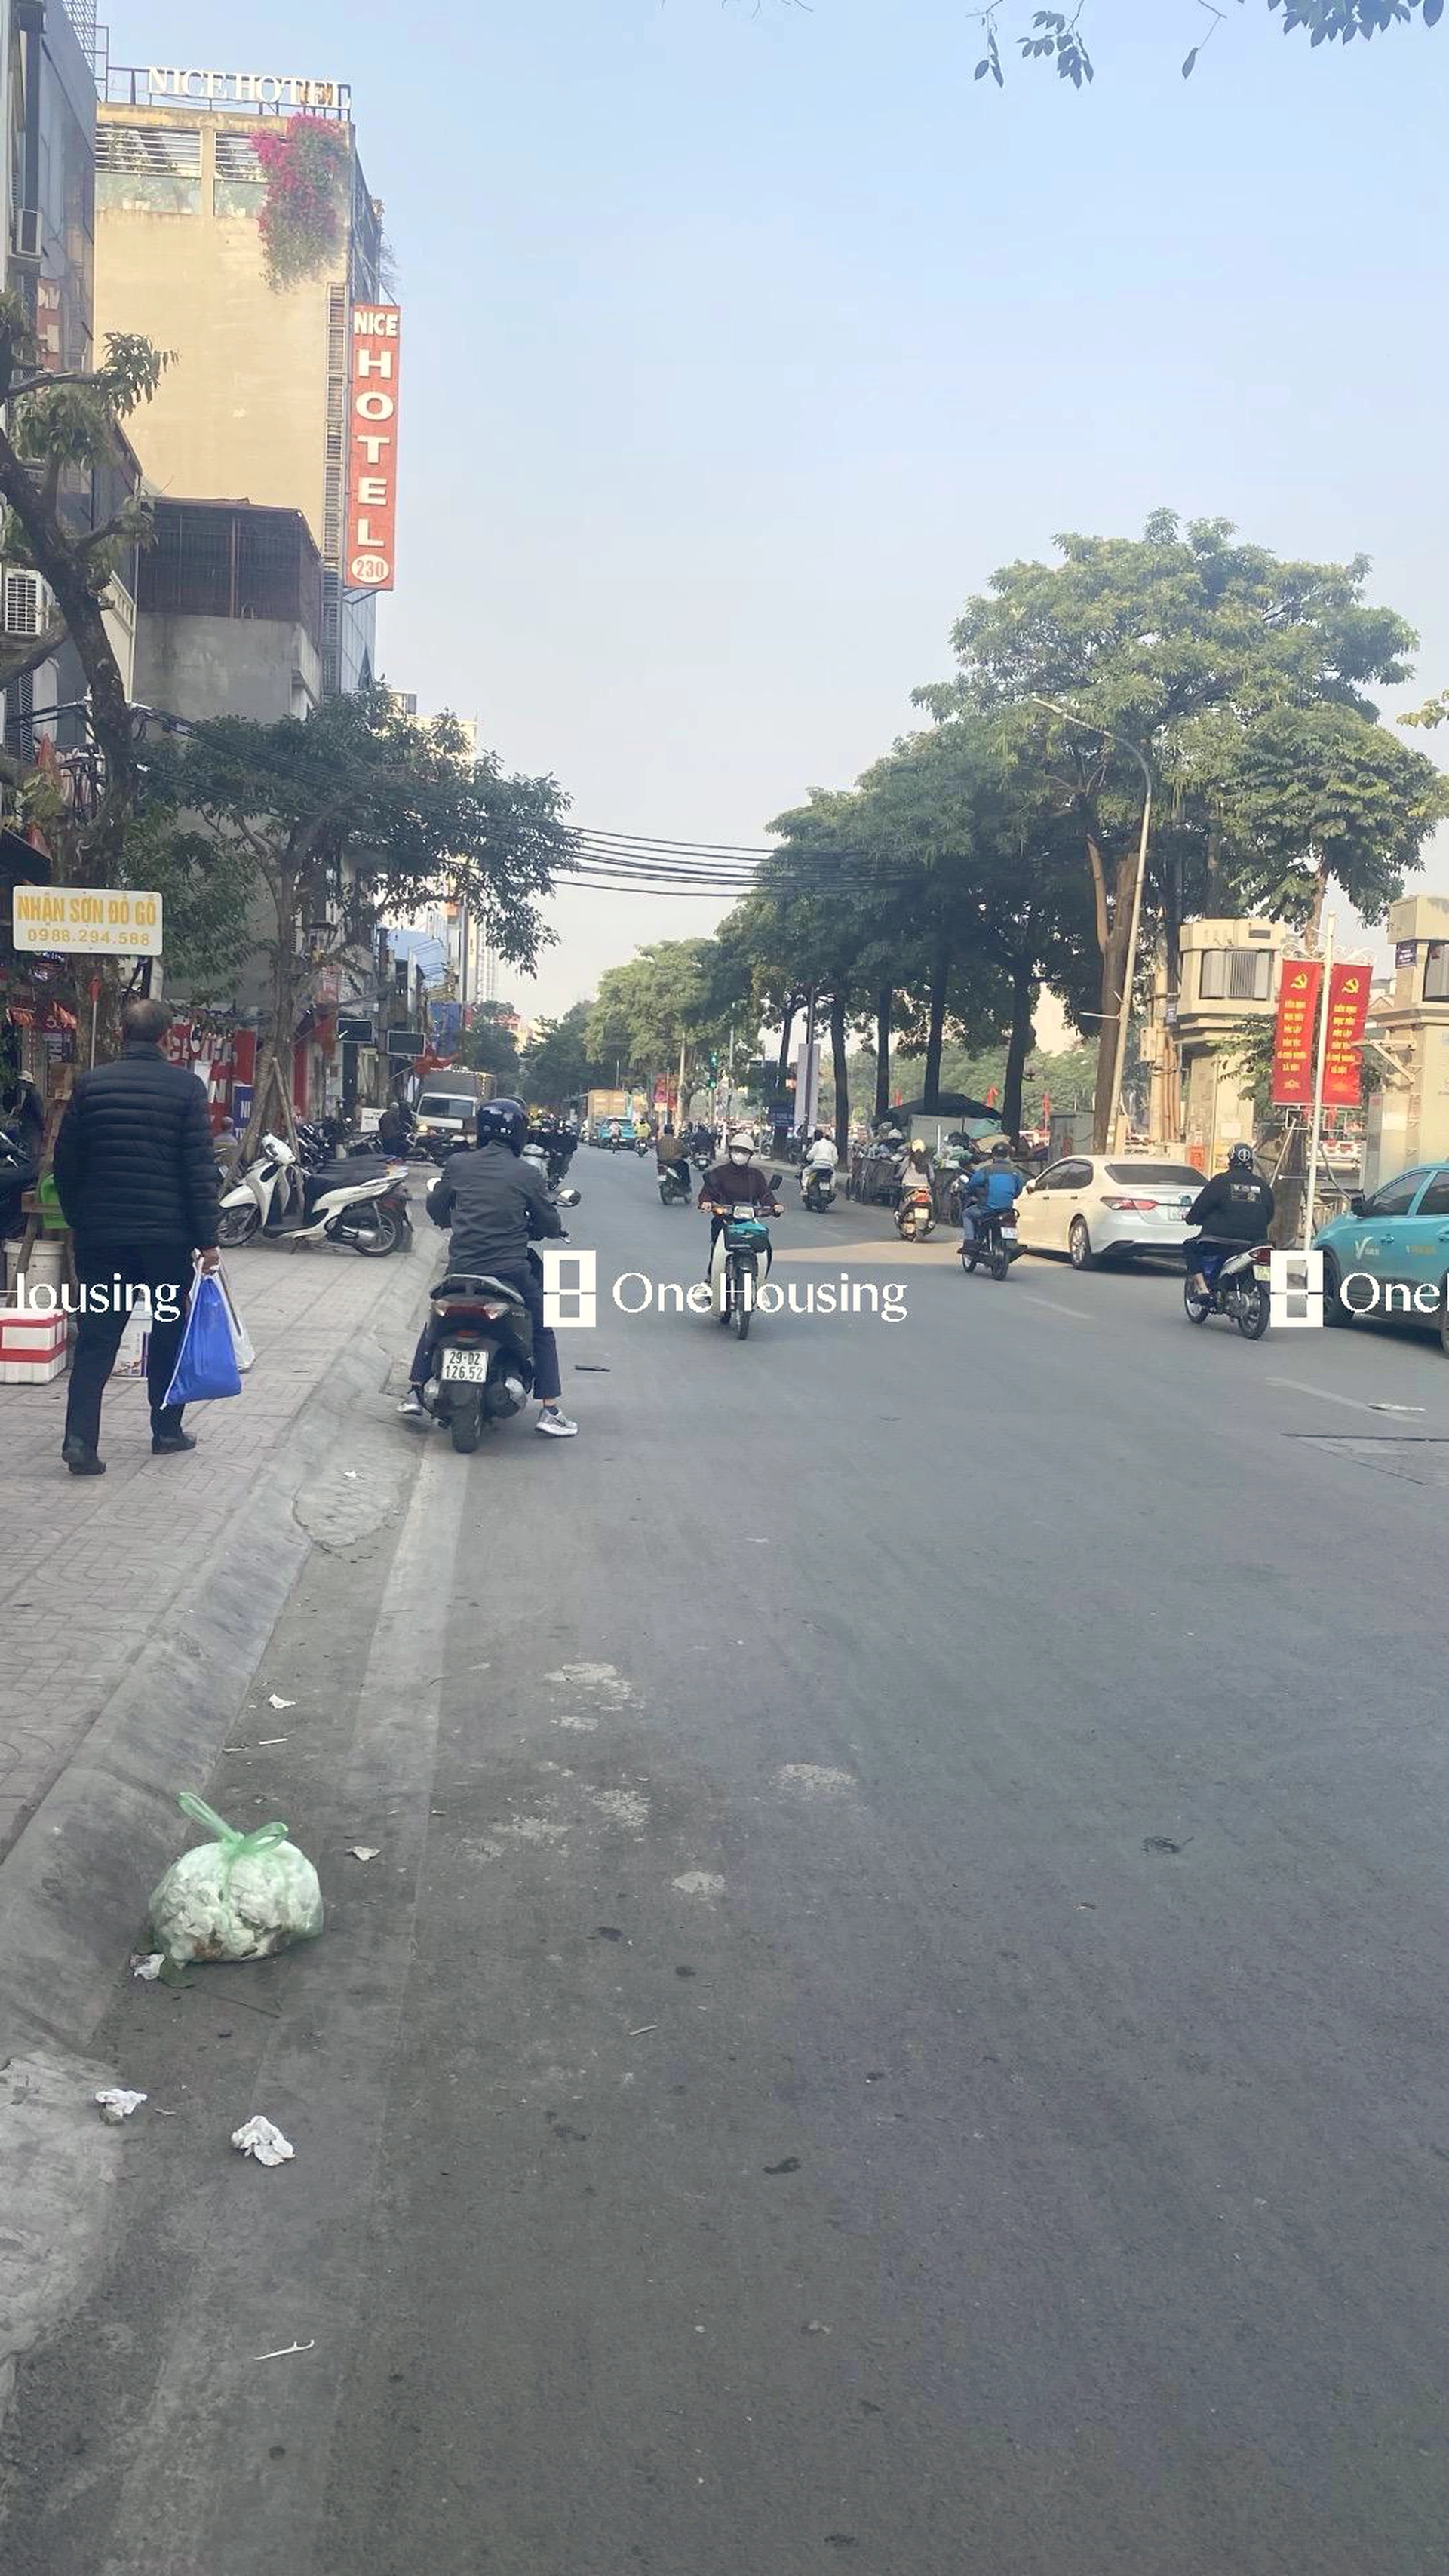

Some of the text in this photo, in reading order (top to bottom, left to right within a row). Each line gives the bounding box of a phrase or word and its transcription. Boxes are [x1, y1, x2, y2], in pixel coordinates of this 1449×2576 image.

[148, 66, 352, 109] NICE HOTEL
[354, 311, 398, 337] NICE
[355, 348, 394, 547] HOTEL
[356, 560, 385, 578] 230
[69, 896, 104, 924] SƠN
